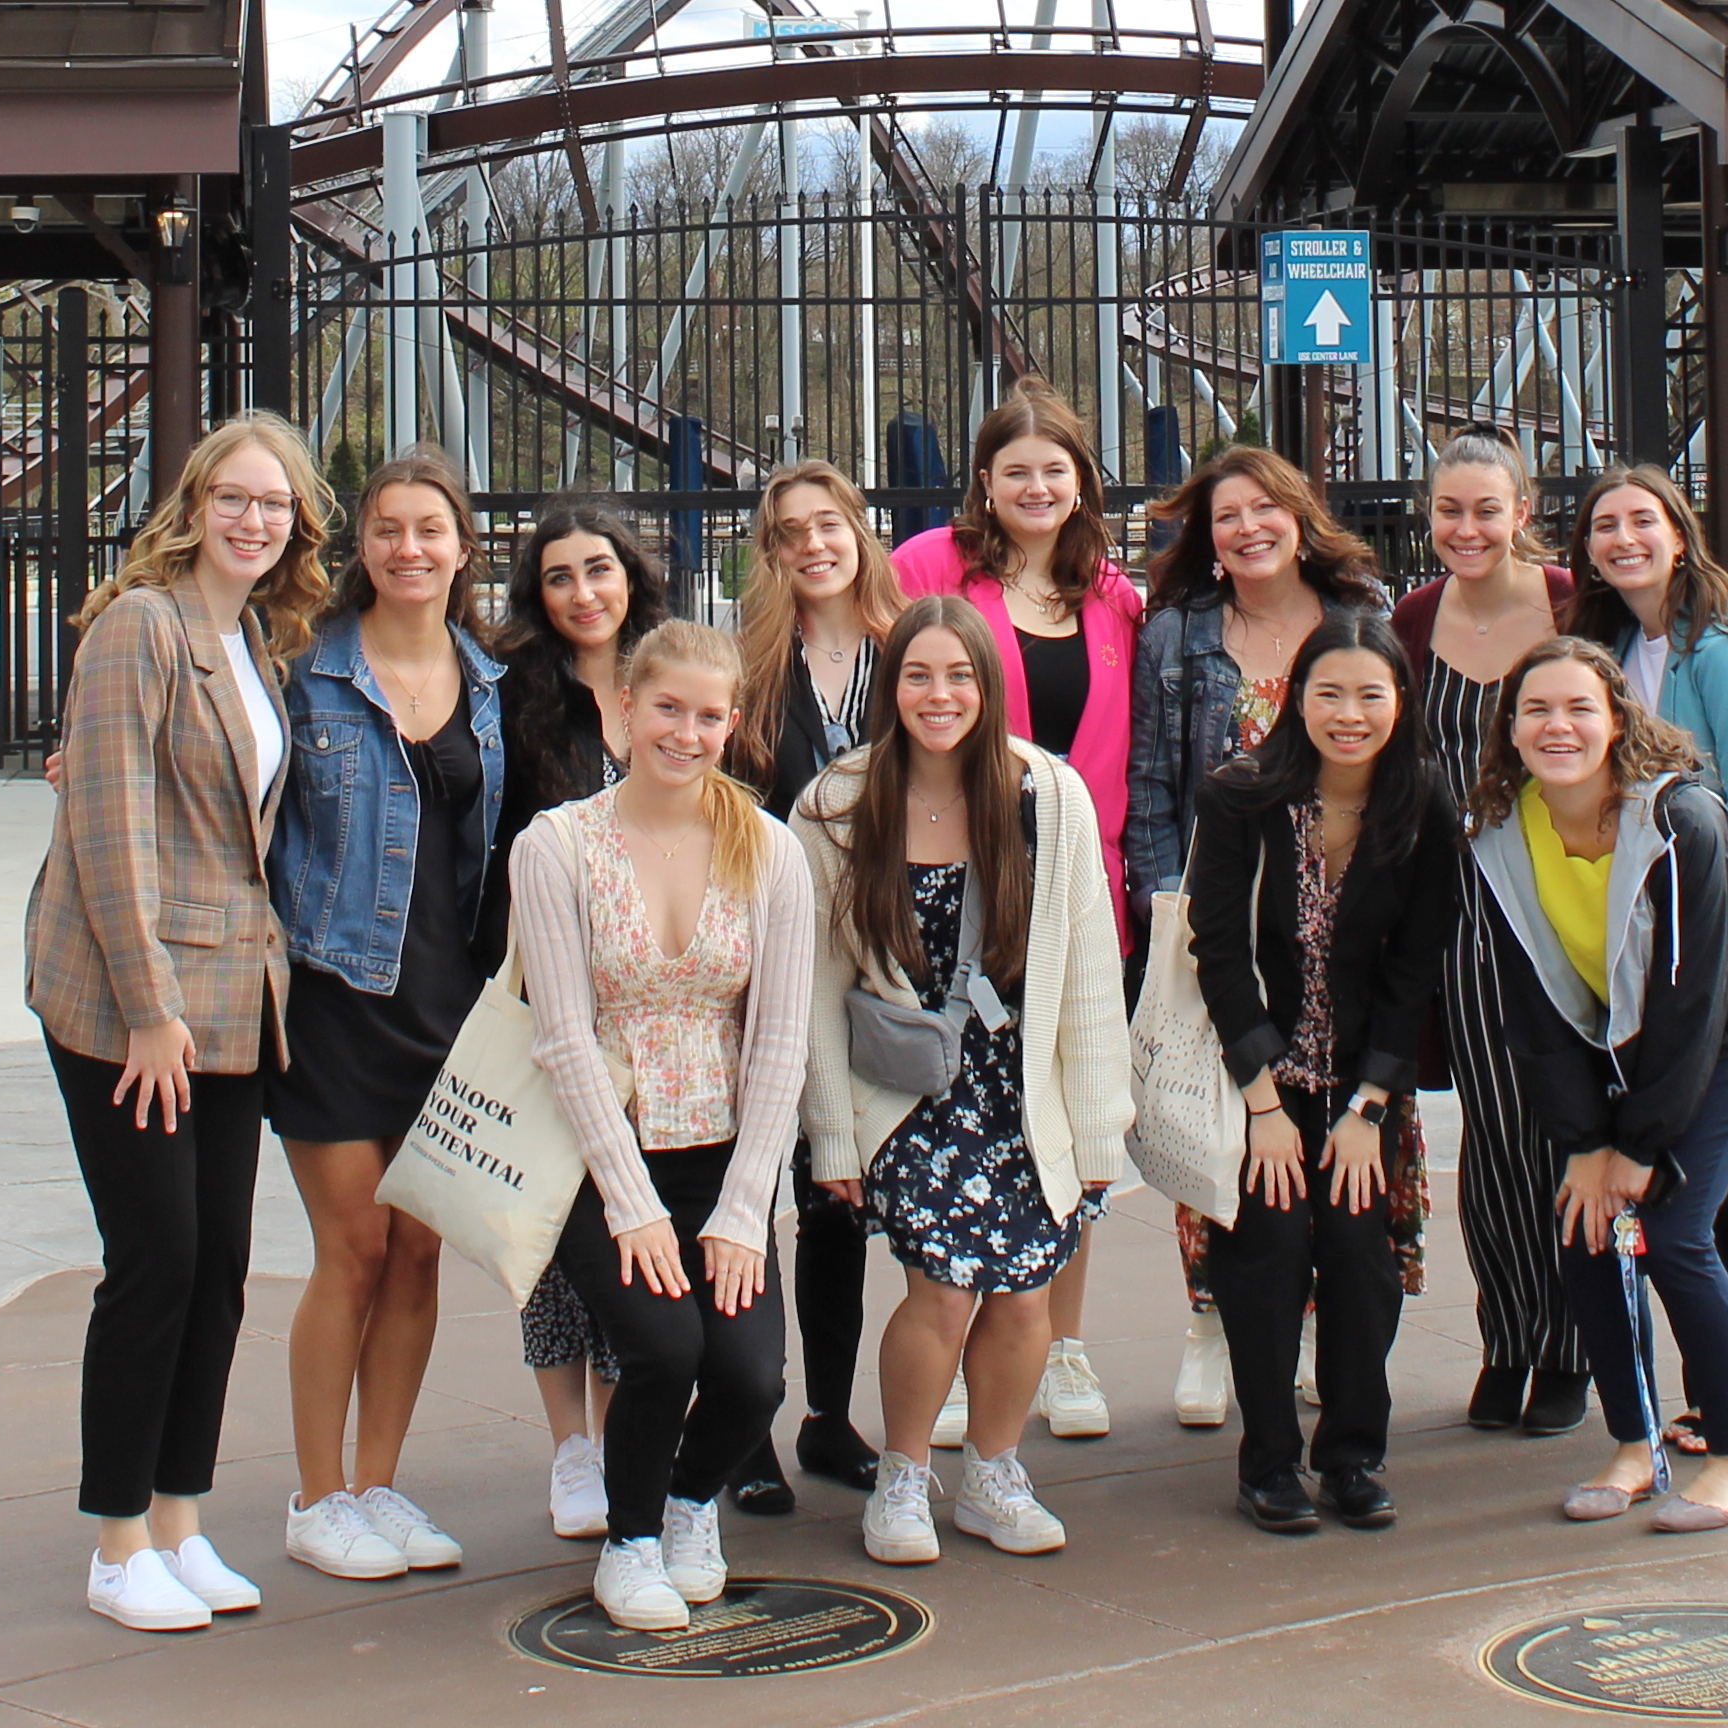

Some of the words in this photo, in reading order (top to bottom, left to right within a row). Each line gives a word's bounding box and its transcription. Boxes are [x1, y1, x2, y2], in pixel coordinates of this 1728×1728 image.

[1290, 240, 1347, 257] STROLLER
[1353, 240, 1363, 256] &
[1287, 262, 1366, 279] WHEELCHAIR
[1339, 352, 1358, 361] LANE
[429, 1090, 477, 1135] YOUR
[438, 1068, 518, 1127] UNLOCK
[417, 1113, 525, 1192] POTENTIAL
